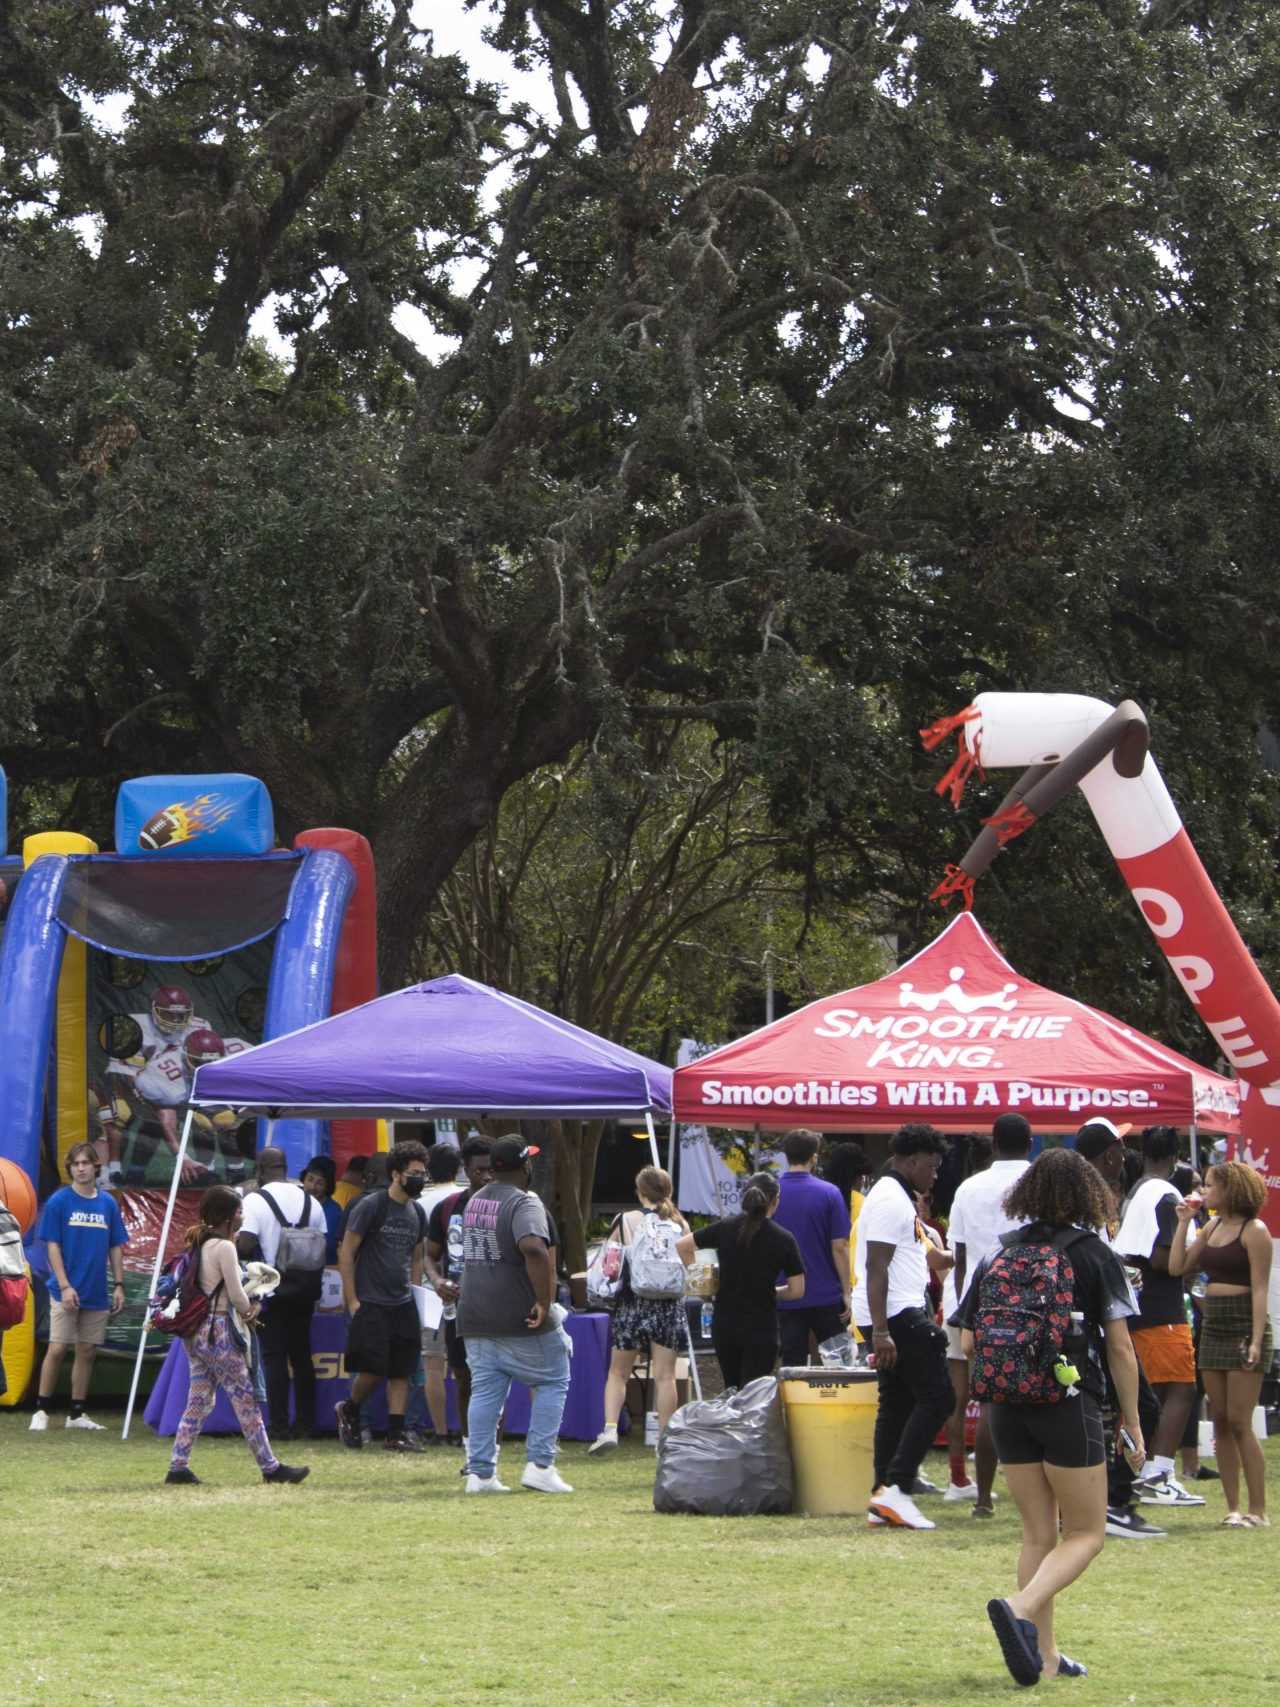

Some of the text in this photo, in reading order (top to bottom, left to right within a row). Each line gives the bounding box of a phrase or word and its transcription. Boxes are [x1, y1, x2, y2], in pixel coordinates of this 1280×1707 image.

[814, 1009, 1072, 1039] SMOOTHIE
[158, 1059, 182, 1082] 50
[701, 1080, 877, 1106] Smoothies
[885, 1080, 966, 1106] With
[973, 1082, 1001, 1107] A
[1007, 1082, 1158, 1112] Purpose.
